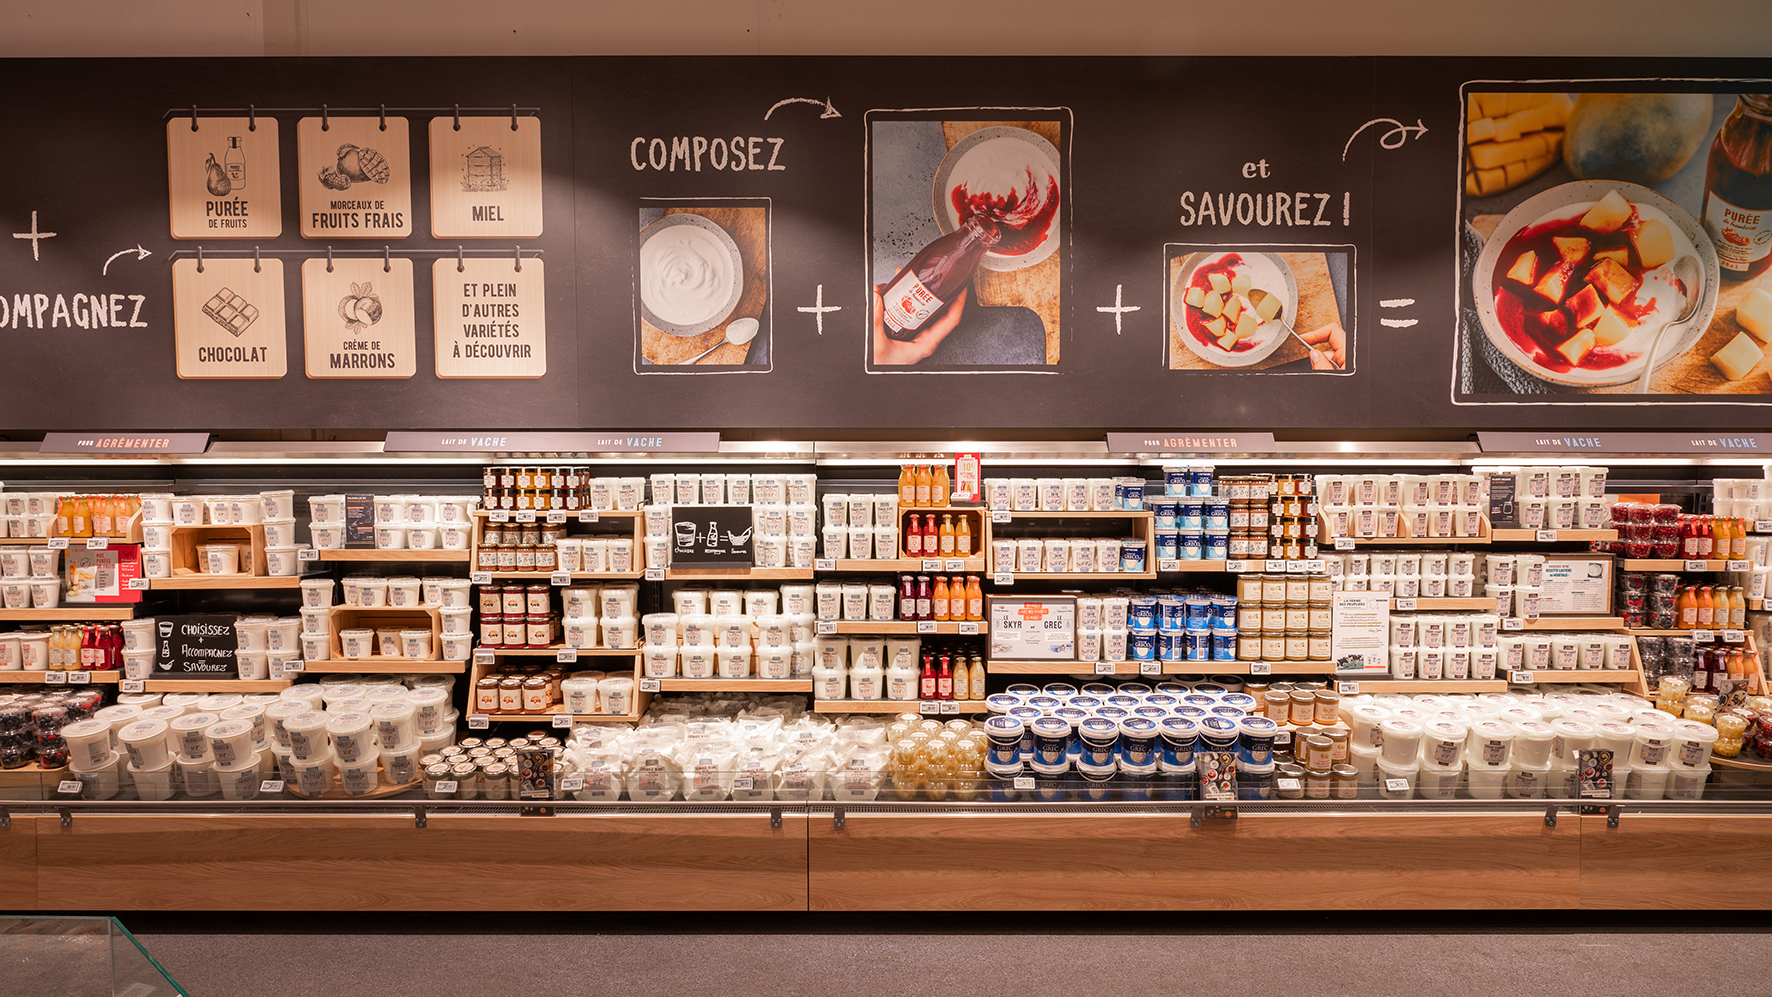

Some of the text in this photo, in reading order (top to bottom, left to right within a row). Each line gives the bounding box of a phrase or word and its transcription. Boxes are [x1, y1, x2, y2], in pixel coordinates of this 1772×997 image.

[631, 136, 785, 171] COMPOSEZ
[1242, 159, 1270, 178] et
[206, 196, 249, 217] PURÉE
[331, 201, 385, 210] MORCEAUX DE
[1180, 191, 1331, 226] SAVOUREZ
[473, 206, 504, 221] MIEL
[1724, 208, 1761, 225] PURÉE
[209, 219, 247, 228] DE FRUITS
[312, 213, 403, 228] FRUITS FRAIS
[464, 284, 516, 297] ET PLEIN
[912, 282, 933, 304] PURÉE
[462, 304, 519, 317] D'AUTRES
[463, 321, 519, 337] VARIÉTÉS
[343, 339, 380, 350] CRÈME DE
[453, 341, 531, 358] À DÉCOUVRIR
[199, 347, 267, 362] CHOCOLAT
[330, 353, 395, 368] MARRONS
[96, 437, 169, 448] AGRÉMENTER
[472, 437, 506, 446] VACHE
[627, 438, 662, 447] VACHE
[1165, 437, 1237, 447] AGRÉMENTER
[1564, 438, 1601, 447] VACHE
[1719, 438, 1758, 448] VACHE
[1003, 620, 1022, 629] SKYR
[1044, 620, 1063, 629] GREC
